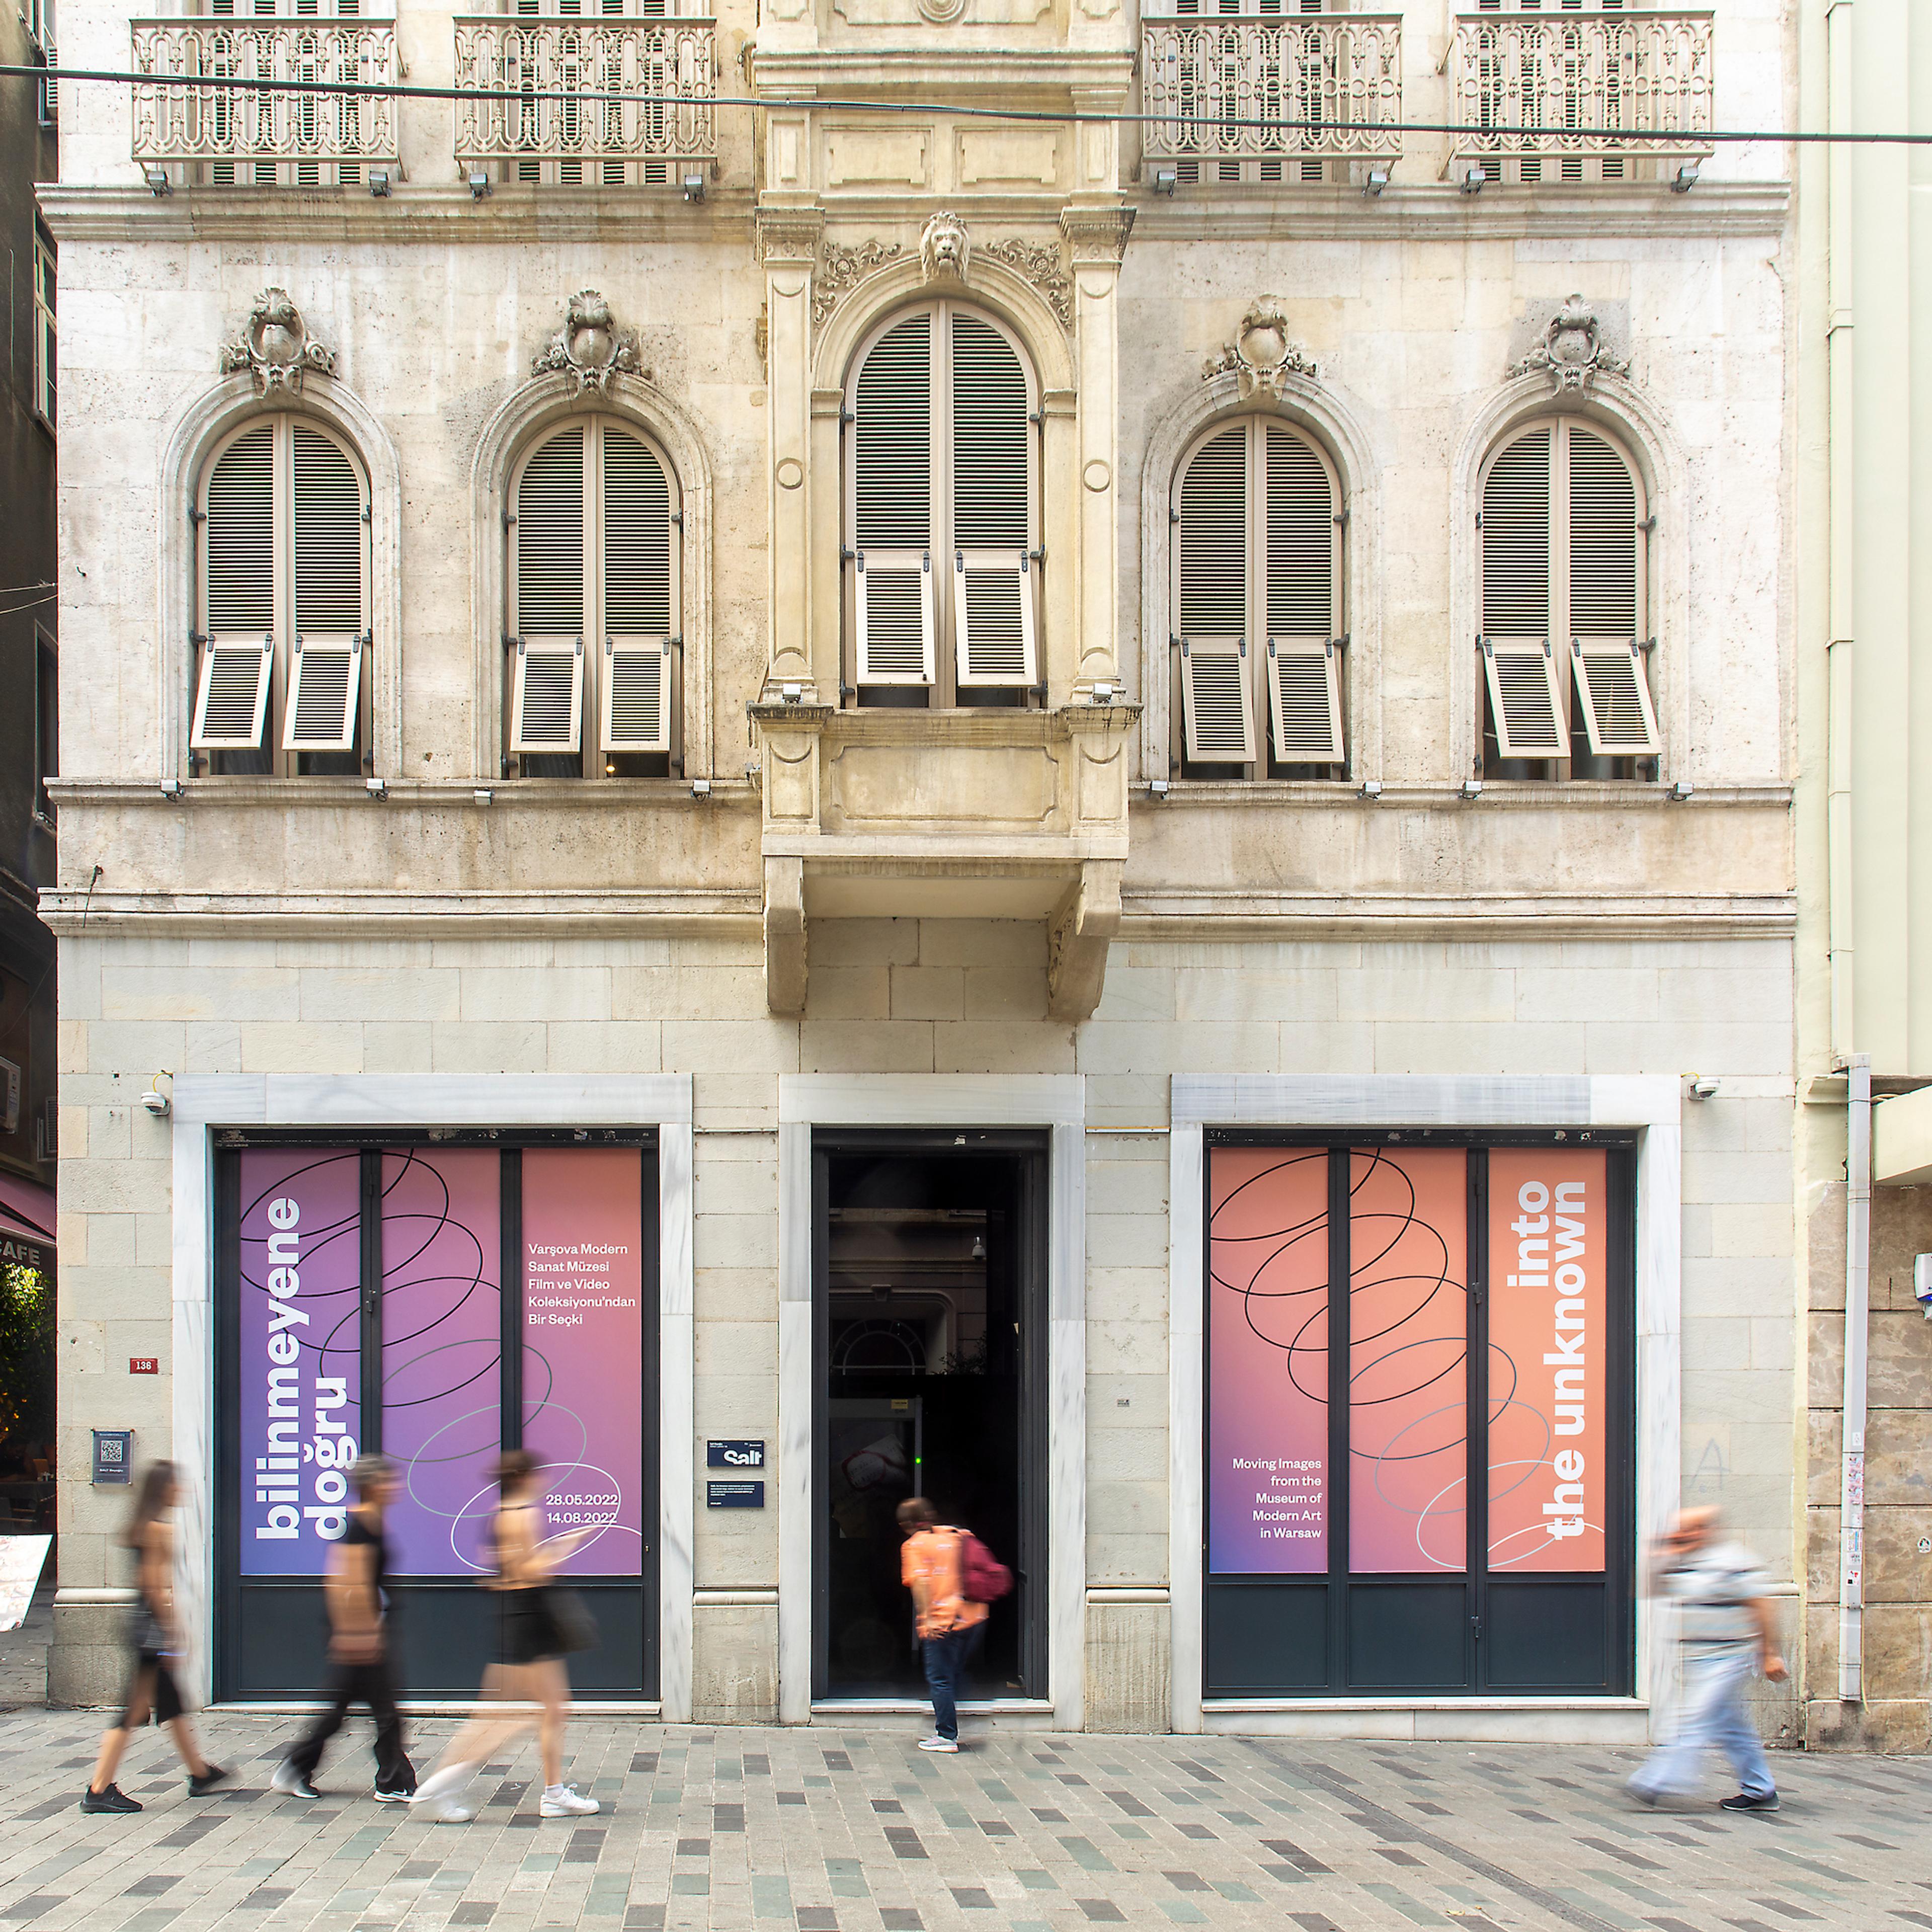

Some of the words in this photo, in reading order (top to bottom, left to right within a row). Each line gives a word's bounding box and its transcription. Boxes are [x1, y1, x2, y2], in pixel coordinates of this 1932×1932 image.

[1507, 1180, 1550, 1287] into
[0, 1240, 41, 1266] AFE
[528, 1243, 579, 1257] Varşova
[581, 1243, 628, 1255] Modern
[528, 1261, 565, 1272] Sanat
[567, 1261, 610, 1272] Müzesi
[528, 1278, 554, 1290] Film
[556, 1281, 572, 1290] ve
[574, 1278, 610, 1290] Video
[1543, 1181, 1586, 1435] unknown
[528, 1314, 546, 1325] Bir
[548, 1314, 583, 1327] Seçki
[136, 1360, 152, 1370] 136
[256, 1197, 310, 1539] bilinmeyene
[303, 1377, 358, 1541] doğru
[723, 1450, 762, 1465] Salt
[1233, 1458, 1277, 1471] Moving
[1278, 1458, 1322, 1471] Images
[1270, 1475, 1300, 1486] from
[1301, 1475, 1322, 1486] the
[546, 1494, 619, 1506] 28.05.2022
[1256, 1493, 1307, 1504] Museum
[1309, 1492, 1323, 1504] of
[1542, 1449, 1585, 1541] the
[547, 1512, 617, 1524] 14.08.2022
[1253, 1510, 1299, 1521] Modern
[1301, 1510, 1322, 1521] Art
[1260, 1527, 1271, 1538] in
[1273, 1527, 1322, 1539] Warsaw
